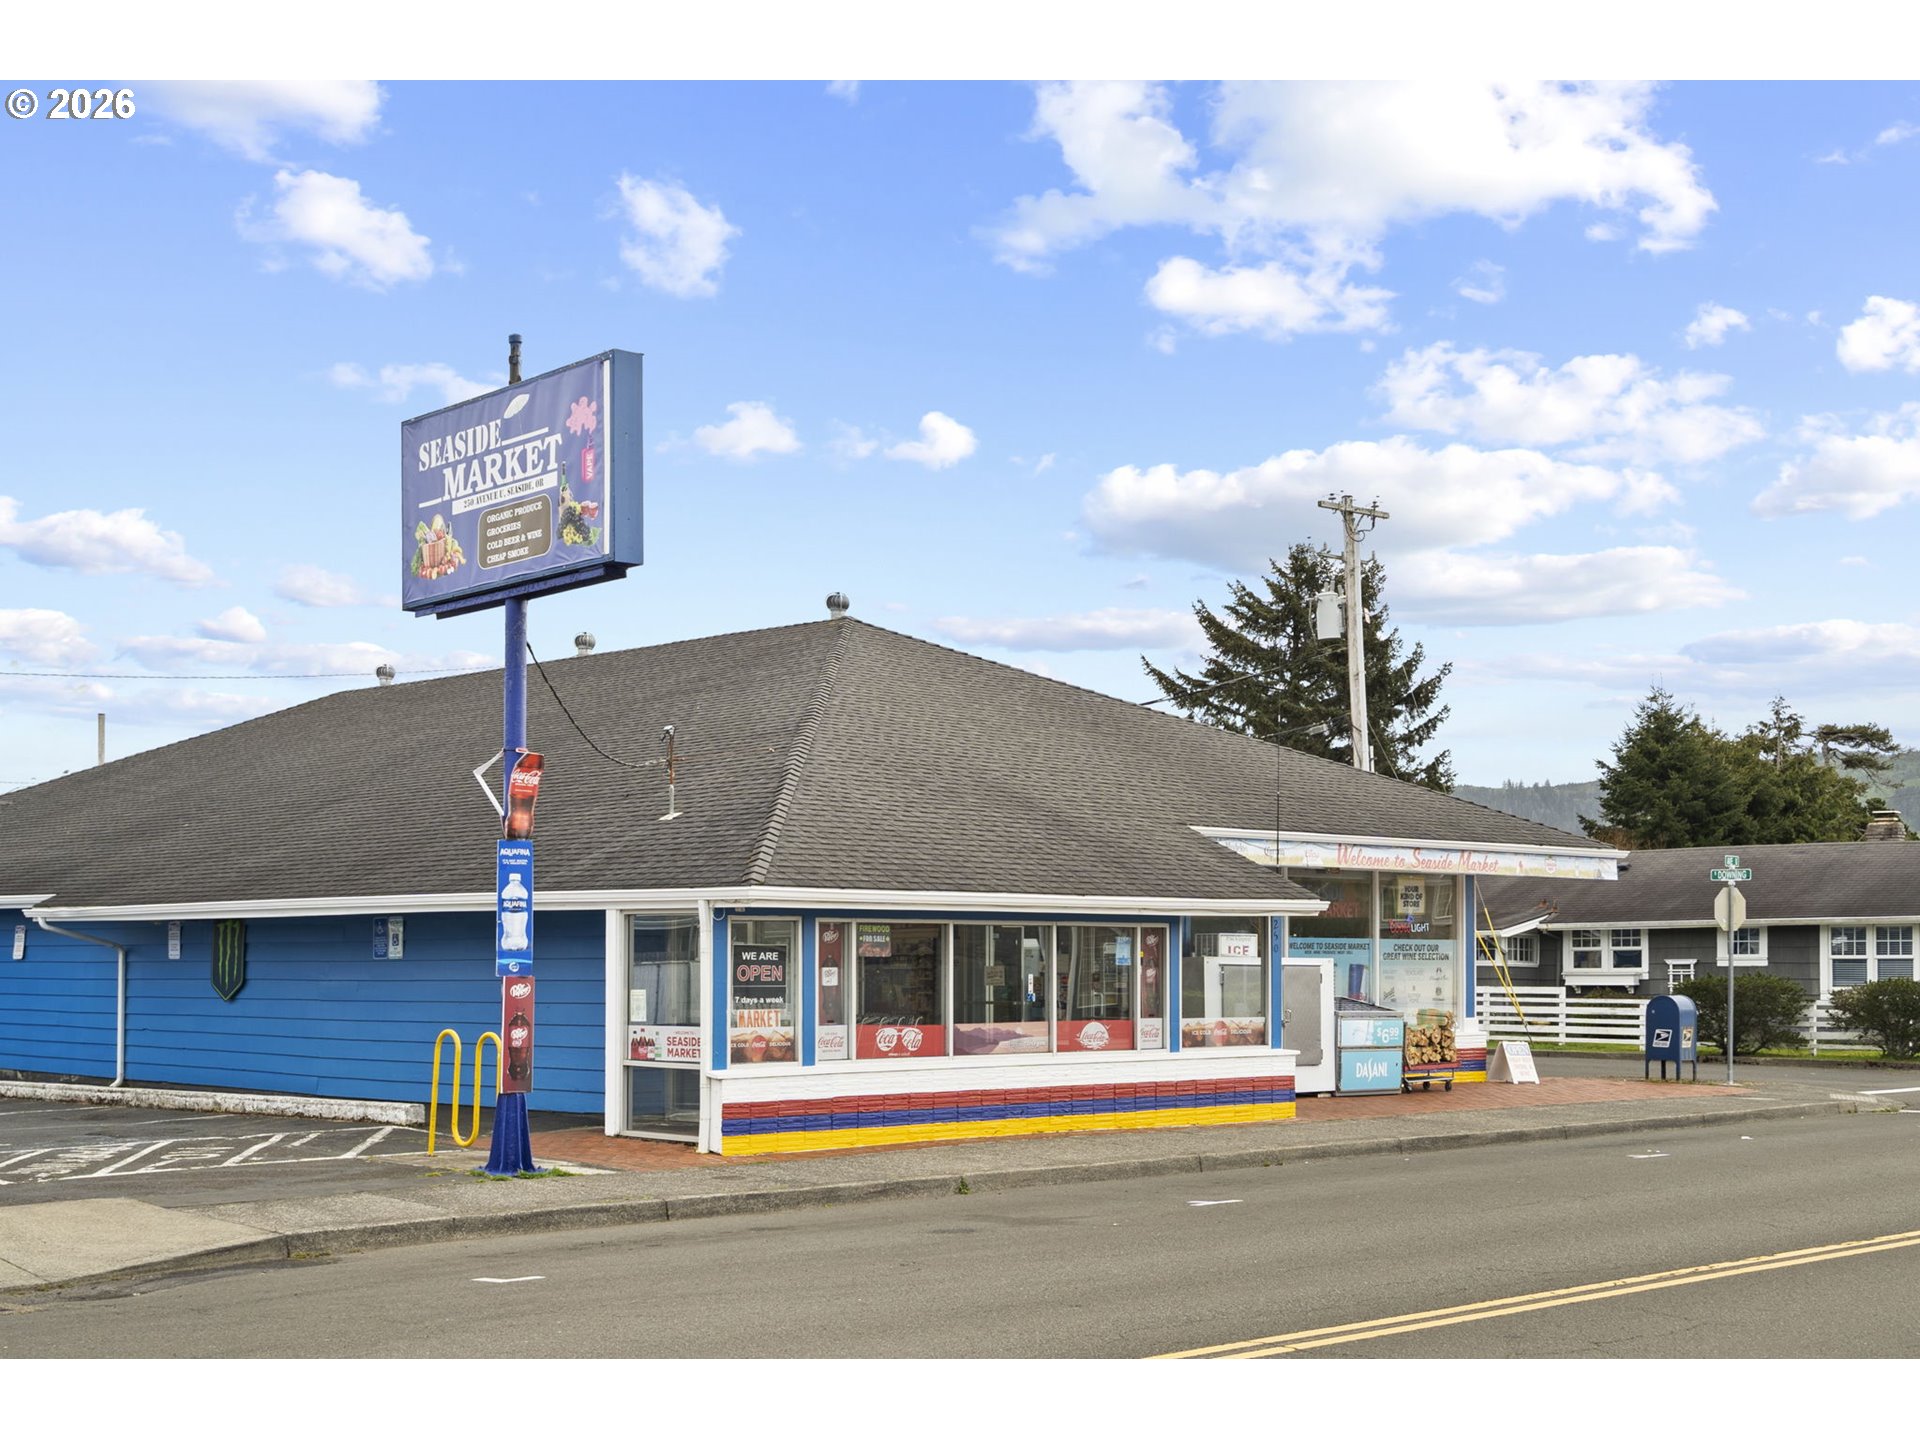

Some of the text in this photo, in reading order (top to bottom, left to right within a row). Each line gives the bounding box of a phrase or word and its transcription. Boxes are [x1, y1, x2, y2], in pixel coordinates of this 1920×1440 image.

[419, 419, 501, 472] SEASIDE
[442, 433, 562, 501] MARKET
[585, 452, 593, 480] VAPE
[476, 492, 498, 505] AVENUE
[535, 478, 544, 488] OR
[487, 501, 543, 523] ORGANIC PRODUCE
[487, 521, 521, 537] GROCERIES
[487, 540, 503, 550] COLD
[503, 535, 521, 546] BEER
[527, 529, 543, 540] WINE
[487, 546, 529, 564] CHEAP SMOKE
[500, 848, 530, 857] AQUAFINA
[1336, 843, 1500, 872] Welcome to Seaside Market
[1717, 870, 1747, 879] DOWNING
[1404, 885, 1420, 893] YOUR
[1402, 899, 1421, 908] STORE
[859, 924, 890, 933] FIREWOOD
[1411, 923, 1430, 934] LIGHT
[863, 934, 886, 943] FOR SALE
[1227, 945, 1250, 956] ICE
[1316, 942, 1324, 950] TO
[1348, 943, 1371, 951] MARKET
[1393, 944, 1440, 952] CHECK OUT OUR
[741, 951, 779, 961] WE ARE
[1383, 952, 1450, 961] GREAT WINE SELECTION
[736, 964, 783, 982] OPEN
[735, 996, 740, 1004] 7
[741, 996, 758, 1006] days
[766, 996, 784, 1004] week
[738, 1009, 781, 1028] MARKET
[666, 1036, 701, 1047] SEASIDE
[818, 1036, 845, 1049] Coca-Cola
[667, 1047, 701, 1059] MARKET
[1355, 1058, 1388, 1082] DASANI
